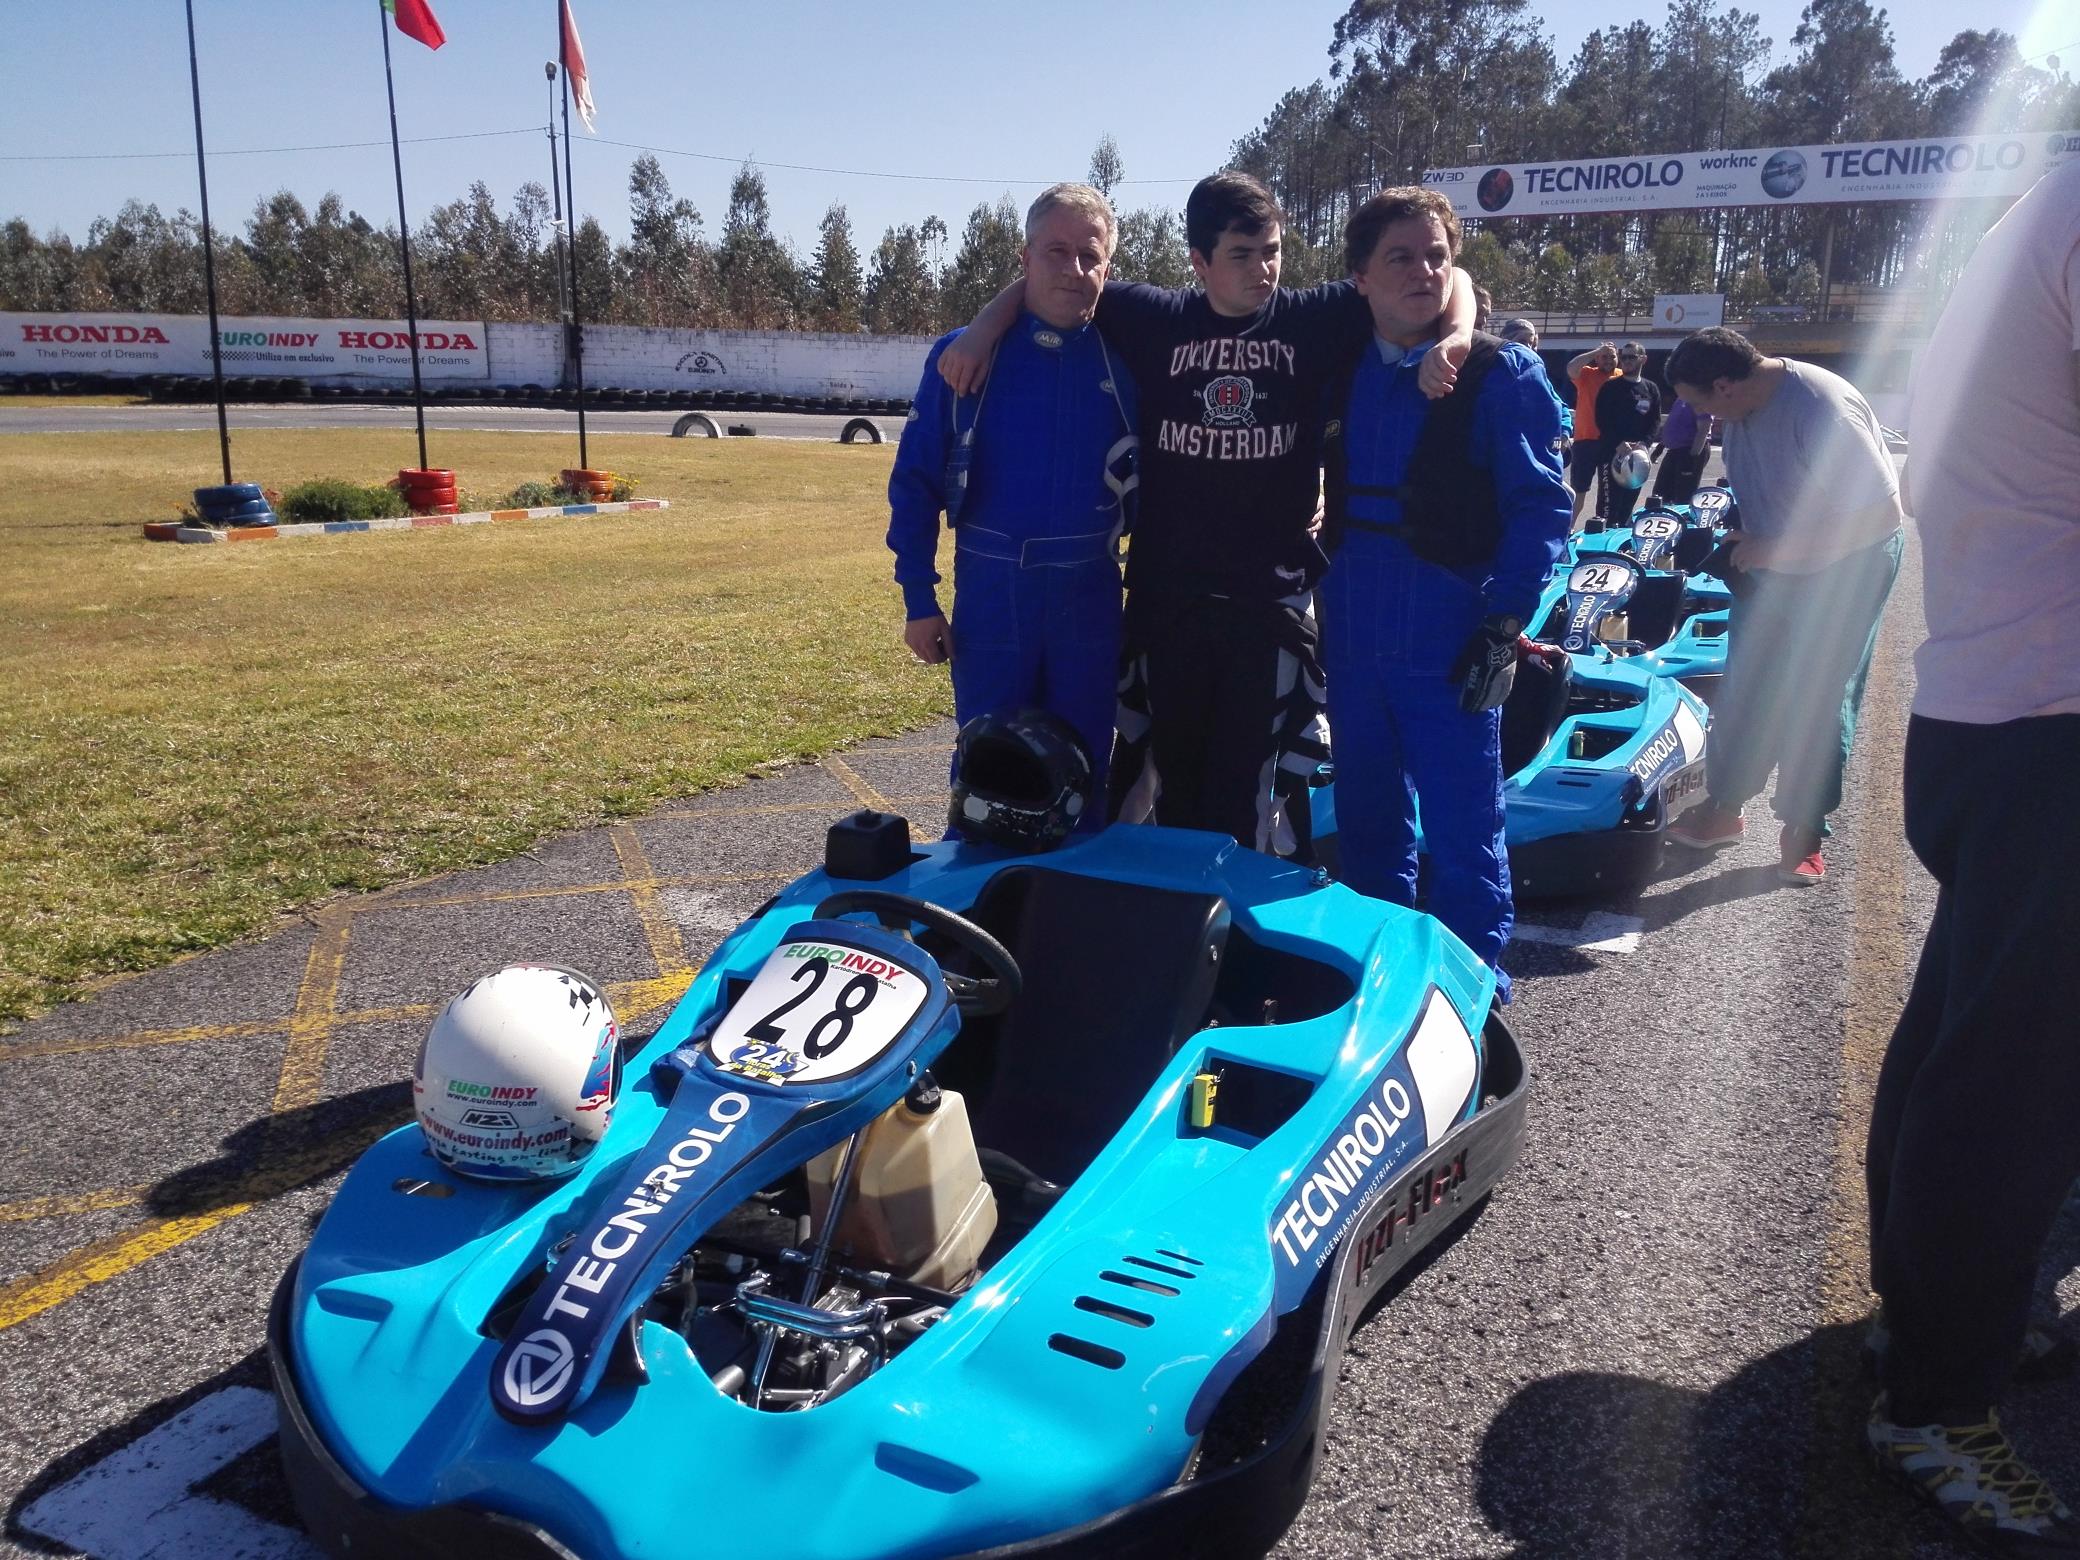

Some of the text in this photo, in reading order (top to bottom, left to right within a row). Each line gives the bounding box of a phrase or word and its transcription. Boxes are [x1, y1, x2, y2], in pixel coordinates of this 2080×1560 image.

[1821, 141, 2026, 178] TECNIROLO
[1524, 160, 1683, 193] TECNIROLO
[21, 325, 170, 344] HONDA
[338, 331, 478, 350] HONDA
[37, 349, 159, 359] The Power of Dreams
[353, 354, 374, 364] The
[378, 355, 411, 364] Power
[429, 356, 470, 365] Dreams
[1158, 419, 1297, 460] AMSTERDAM
[1700, 493, 1723, 508] 27
[1642, 519, 1671, 534] 25
[1580, 568, 1611, 588] 24
[783, 944, 905, 981] EUROINDY
[743, 957, 879, 1060] 28
[739, 1045, 788, 1069] 24
[446, 1092, 538, 1108] www.euroindy.com
[447, 1079, 538, 1100] EUROINDY
[424, 1116, 569, 1151] www.euroindy.com
[1273, 1078, 1411, 1267] TECNIROLO
[543, 1092, 751, 1321] TECNIROLO
[1315, 1208, 1358, 1268] ENGENHARIA
